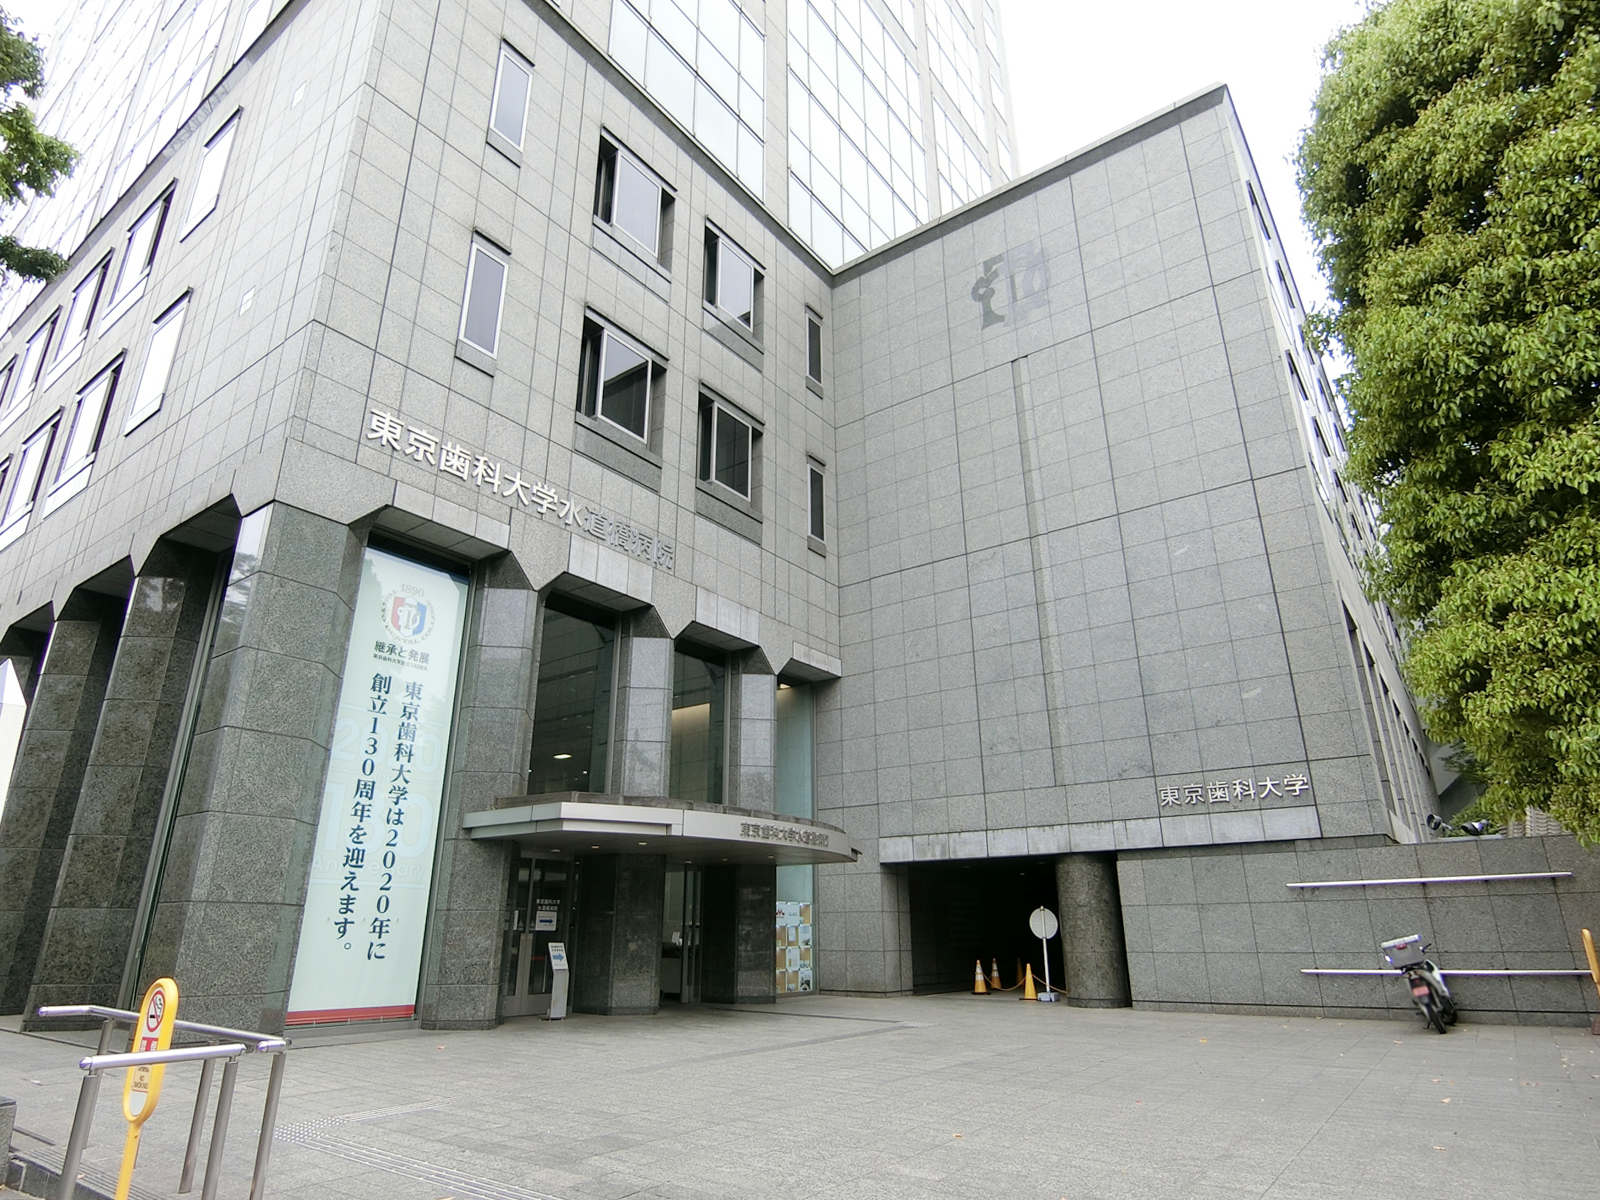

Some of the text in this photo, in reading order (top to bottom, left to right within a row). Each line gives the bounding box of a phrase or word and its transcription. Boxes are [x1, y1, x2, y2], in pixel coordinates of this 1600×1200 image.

[366, 408, 675, 569] 東京歯科大学水道橋病院
[400, 583, 424, 598] 1890
[373, 640, 430, 665] 継承と発展
[334, 673, 392, 951] 創立130周年を迎えます。
[367, 681, 424, 961] 東京歯科大学は2020年に
[1158, 773, 1310, 807] 東京歯科大学
